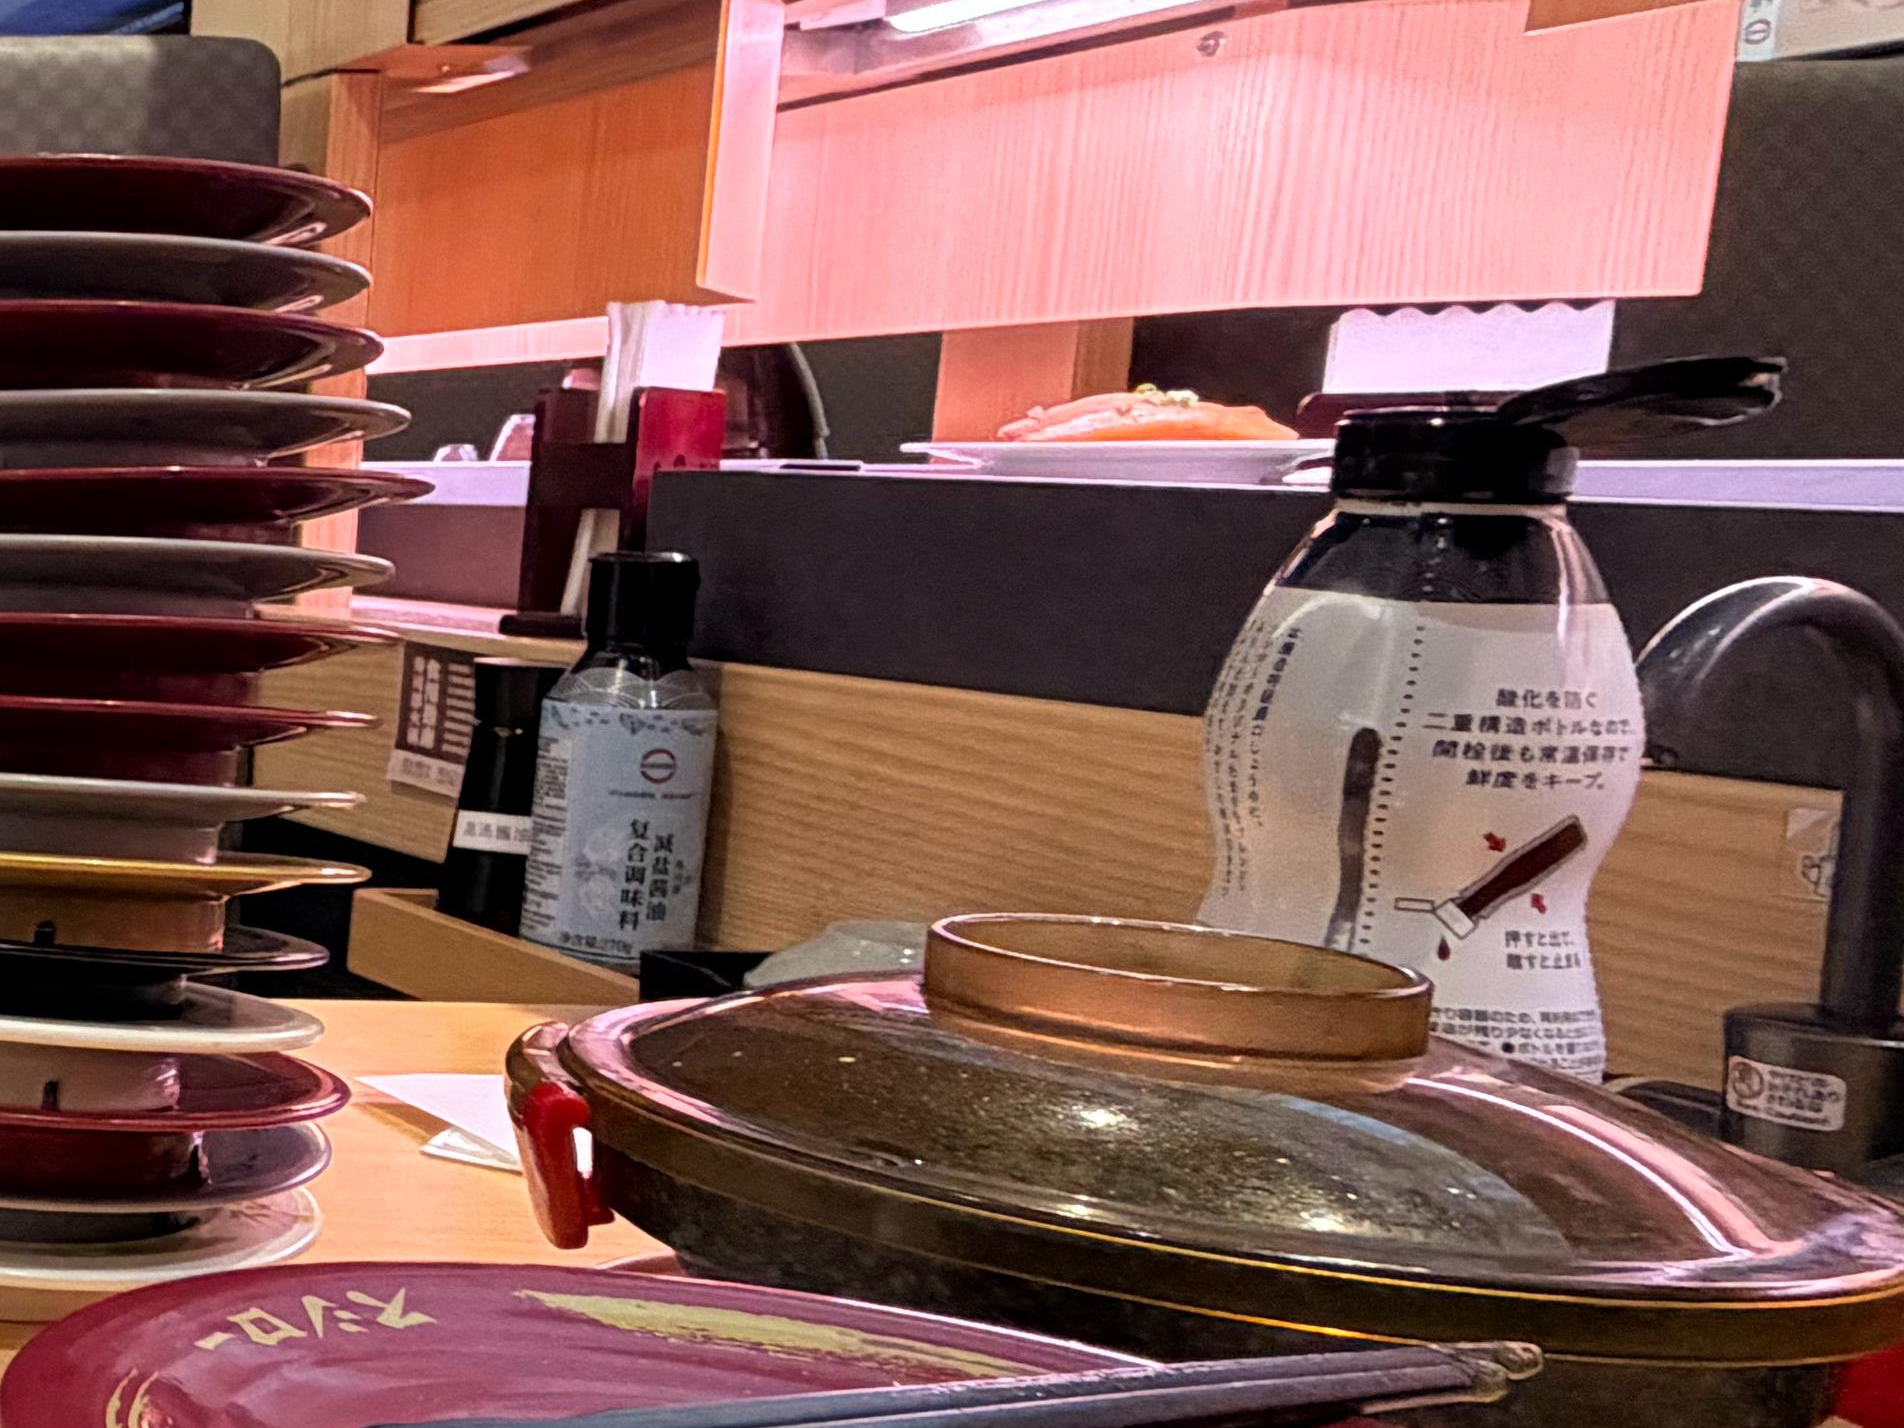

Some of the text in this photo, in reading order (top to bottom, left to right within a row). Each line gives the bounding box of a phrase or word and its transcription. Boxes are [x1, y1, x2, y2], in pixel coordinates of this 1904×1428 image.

[1495, 688, 1598, 710] 酸化を防ぐ
[618, 818, 651, 932] 复合调味料
[645, 833, 675, 922] 减盐酱油
[193, 1286, 439, 1352] スシロー
